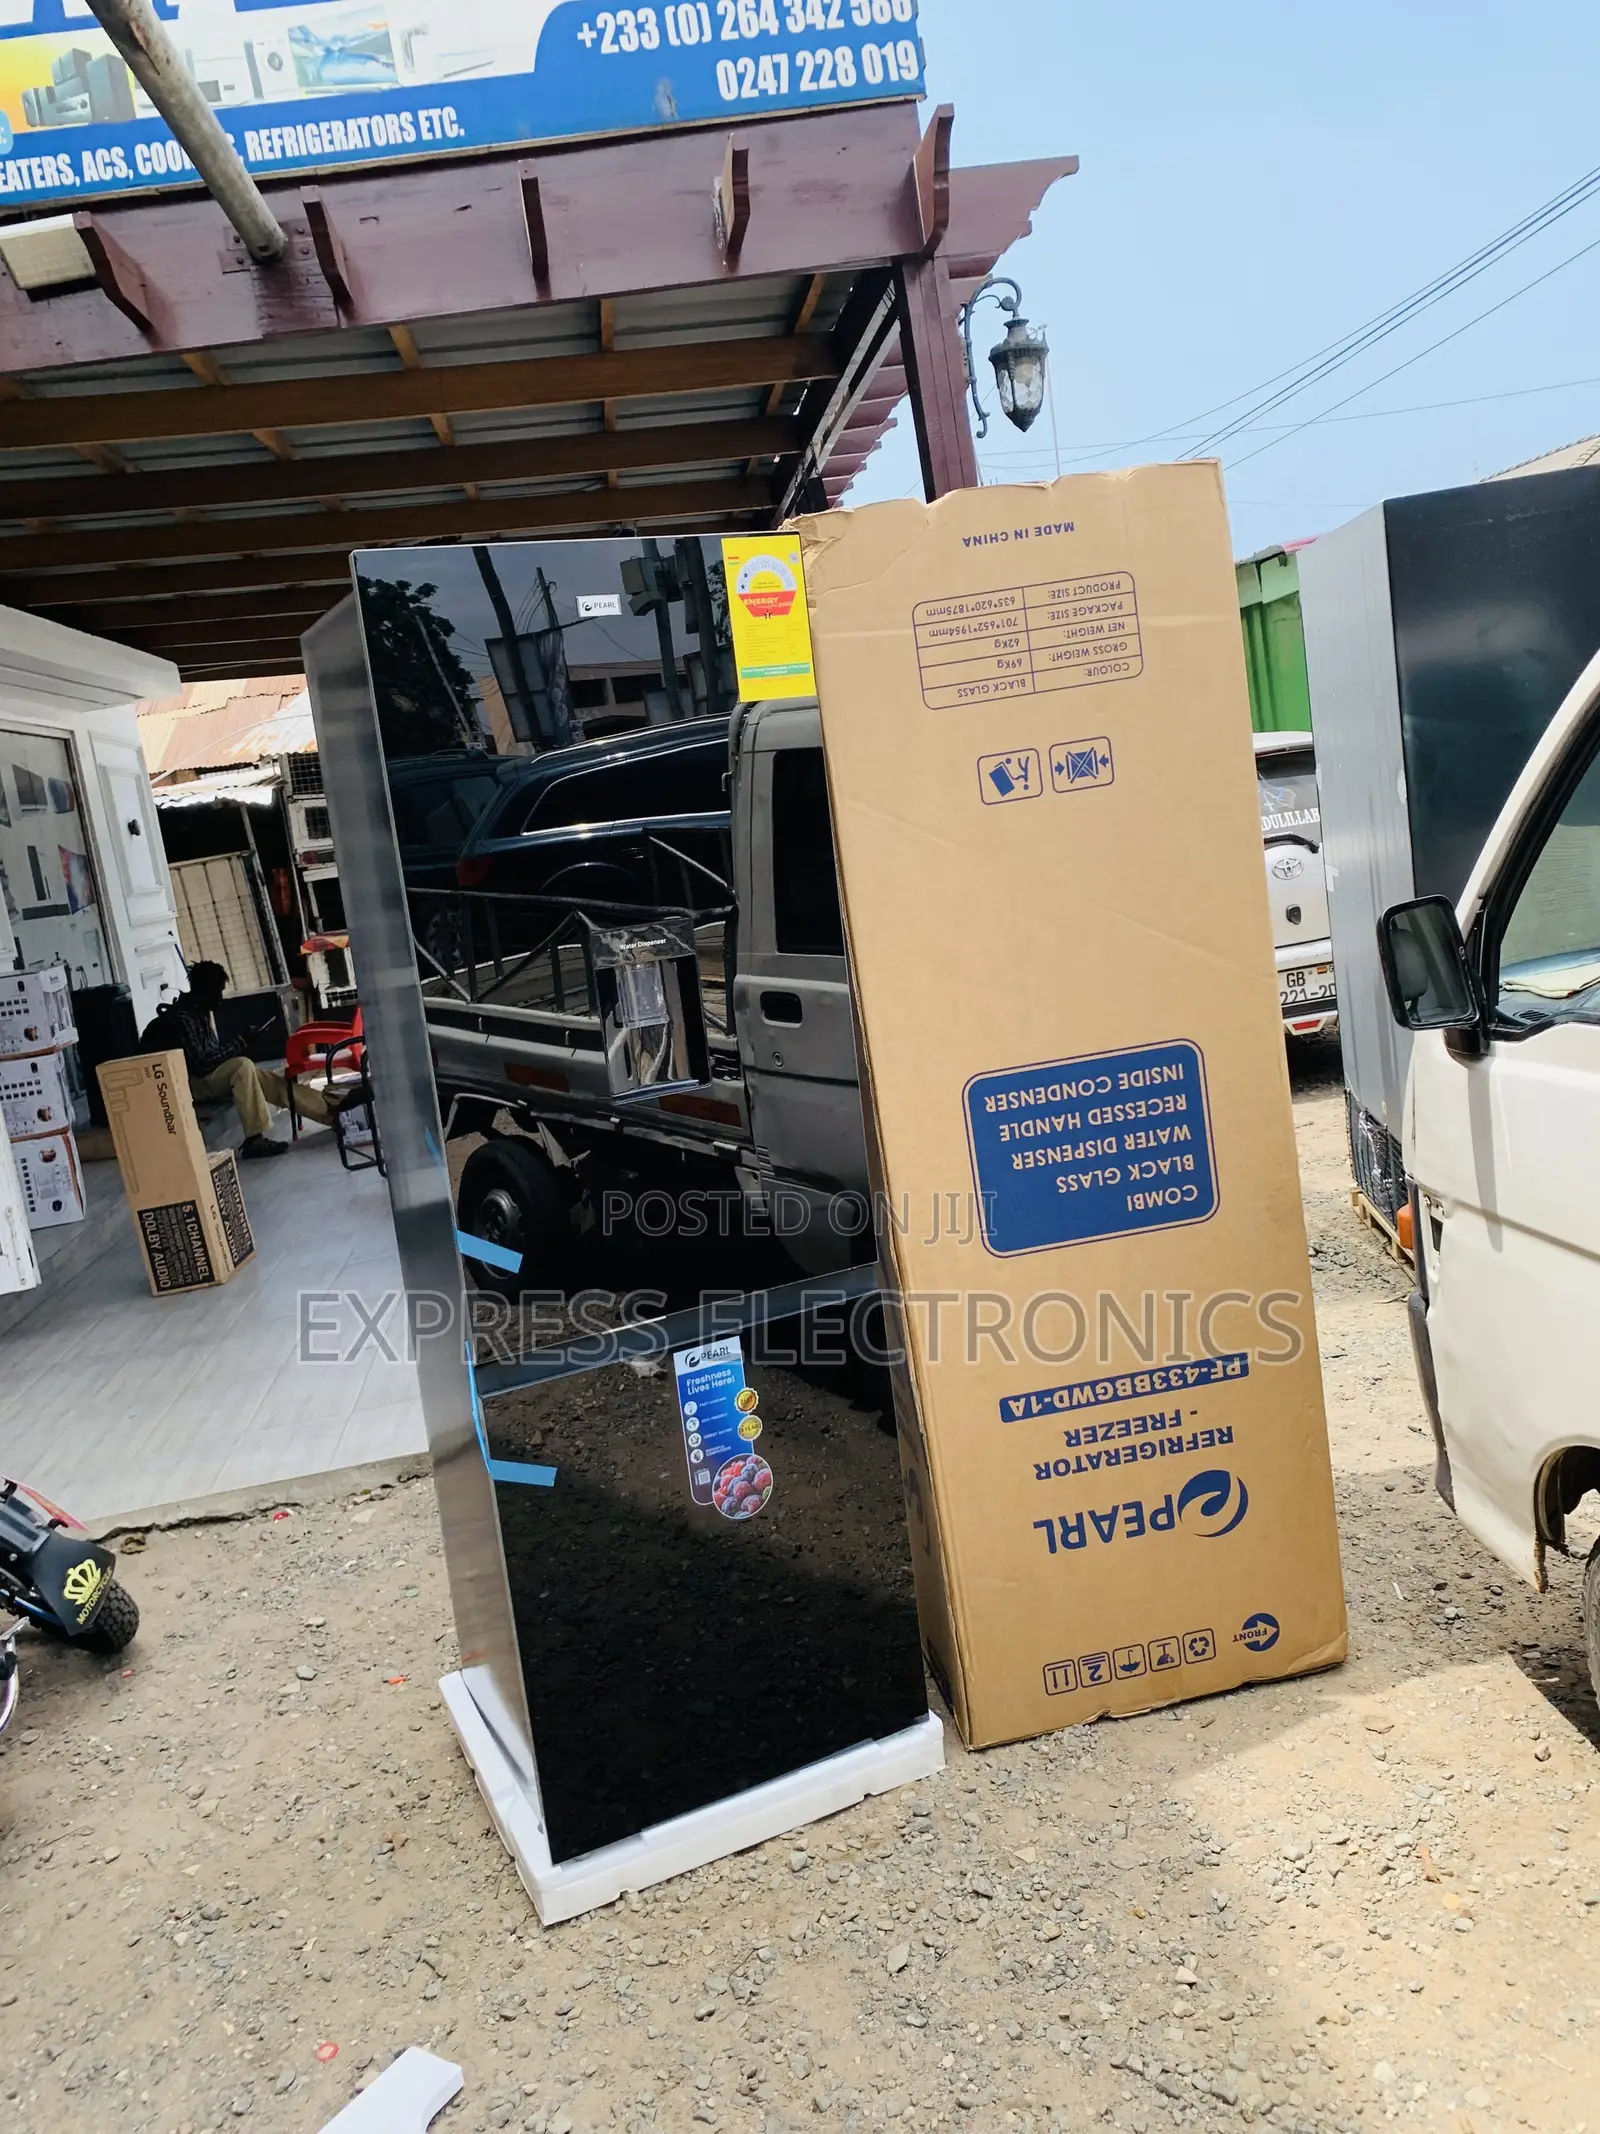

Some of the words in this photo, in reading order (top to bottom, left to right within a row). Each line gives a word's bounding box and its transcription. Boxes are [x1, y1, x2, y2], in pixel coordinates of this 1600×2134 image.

[577, 7, 660, 54] +233
[664, 4, 712, 46] (0)
[717, 0, 779, 41] 264
[783, 0, 845, 34] 342
[716, 53, 789, 101] 0247
[796, 46, 857, 92] 228
[861, 39, 919, 85] 019
[81, 146, 134, 183] ACS,
[244, 114, 416, 163] REFRIGERATORS
[418, 106, 465, 142] ETC.
[1013, 529, 1029, 540] IN
[1034, 522, 1074, 537] MADE
[962, 532, 1008, 547] CHINA
[1047, 589, 1070, 599] SIZE:
[1073, 580, 1121, 595] PRODUCT
[593, 601, 617, 610] PEARL
[743, 596, 779, 606] ENERGY
[1072, 601, 1123, 616] PACKAGE
[1047, 609, 1070, 620] SIZE:
[1062, 625, 1105, 639] WEIGHT:
[1107, 621, 1125, 632] NET
[994, 638, 1019, 649] 62Kg
[1093, 642, 1127, 654] GROSS
[1048, 648, 1090, 661] WEIGHT:
[997, 658, 1023, 670] 69Kg
[1084, 663, 1130, 676] COLOUR:
[957, 684, 989, 698] GLASS
[993, 678, 1026, 693] BLACK
[620, 942, 637, 950] Water
[638, 938, 667, 948] Dispenser
[1287, 971, 1305, 988] GB
[152, 1063, 162, 1080] LG
[1118, 1063, 1184, 1089] INSIDE
[984, 1076, 1112, 1113] CONDENSER
[156, 1083, 177, 1135] Soundbar
[1087, 1094, 1187, 1125] RECESSED
[999, 1112, 1081, 1142] HANDLE
[1124, 1124, 1192, 1151] WATER
[1011, 1136, 1117, 1170] DISPENSER
[1128, 1154, 1195, 1180] BLACK
[1056, 1167, 1121, 1194] GLASS
[1127, 1184, 1198, 1211] COMBI
[224, 1219, 239, 1263] AUDIO
[142, 1212, 161, 1250] DOLBY
[153, 1253, 172, 1288] AUDIO
[700, 1346, 731, 1361] PEARL
[686, 1369, 732, 1386] Freshness
[687, 1383, 710, 1395] Lives
[711, 1375, 735, 1389] Here!
[1008, 1357, 1241, 1414] PF-433BBGWD-1A
[1063, 1409, 1182, 1447] FREEZER
[1033, 1425, 1234, 1481] REFRIGERATOR
[1033, 1494, 1175, 1554] PEARL
[76, 1566, 113, 1625] MOTORCYCLE
[1232, 1628, 1267, 1642] FRONT
